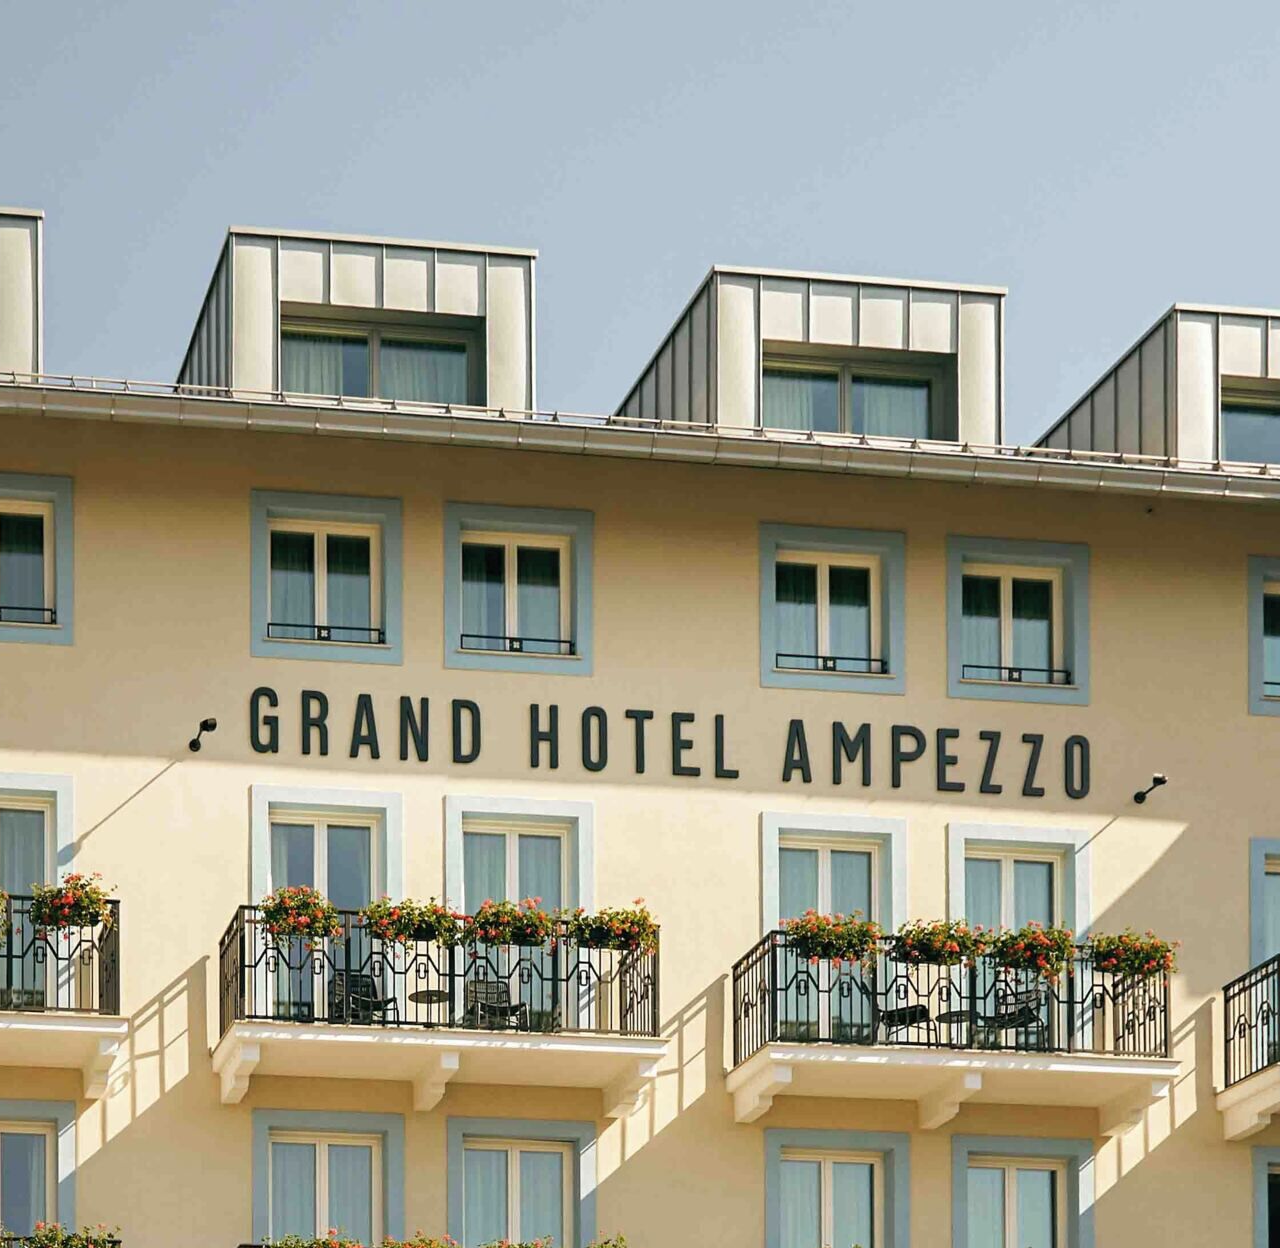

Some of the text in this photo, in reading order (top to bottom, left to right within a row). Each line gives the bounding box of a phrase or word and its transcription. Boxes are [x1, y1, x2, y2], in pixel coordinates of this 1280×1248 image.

[248, 686, 1091, 799] GRAND HOTEL AMPEZZO
